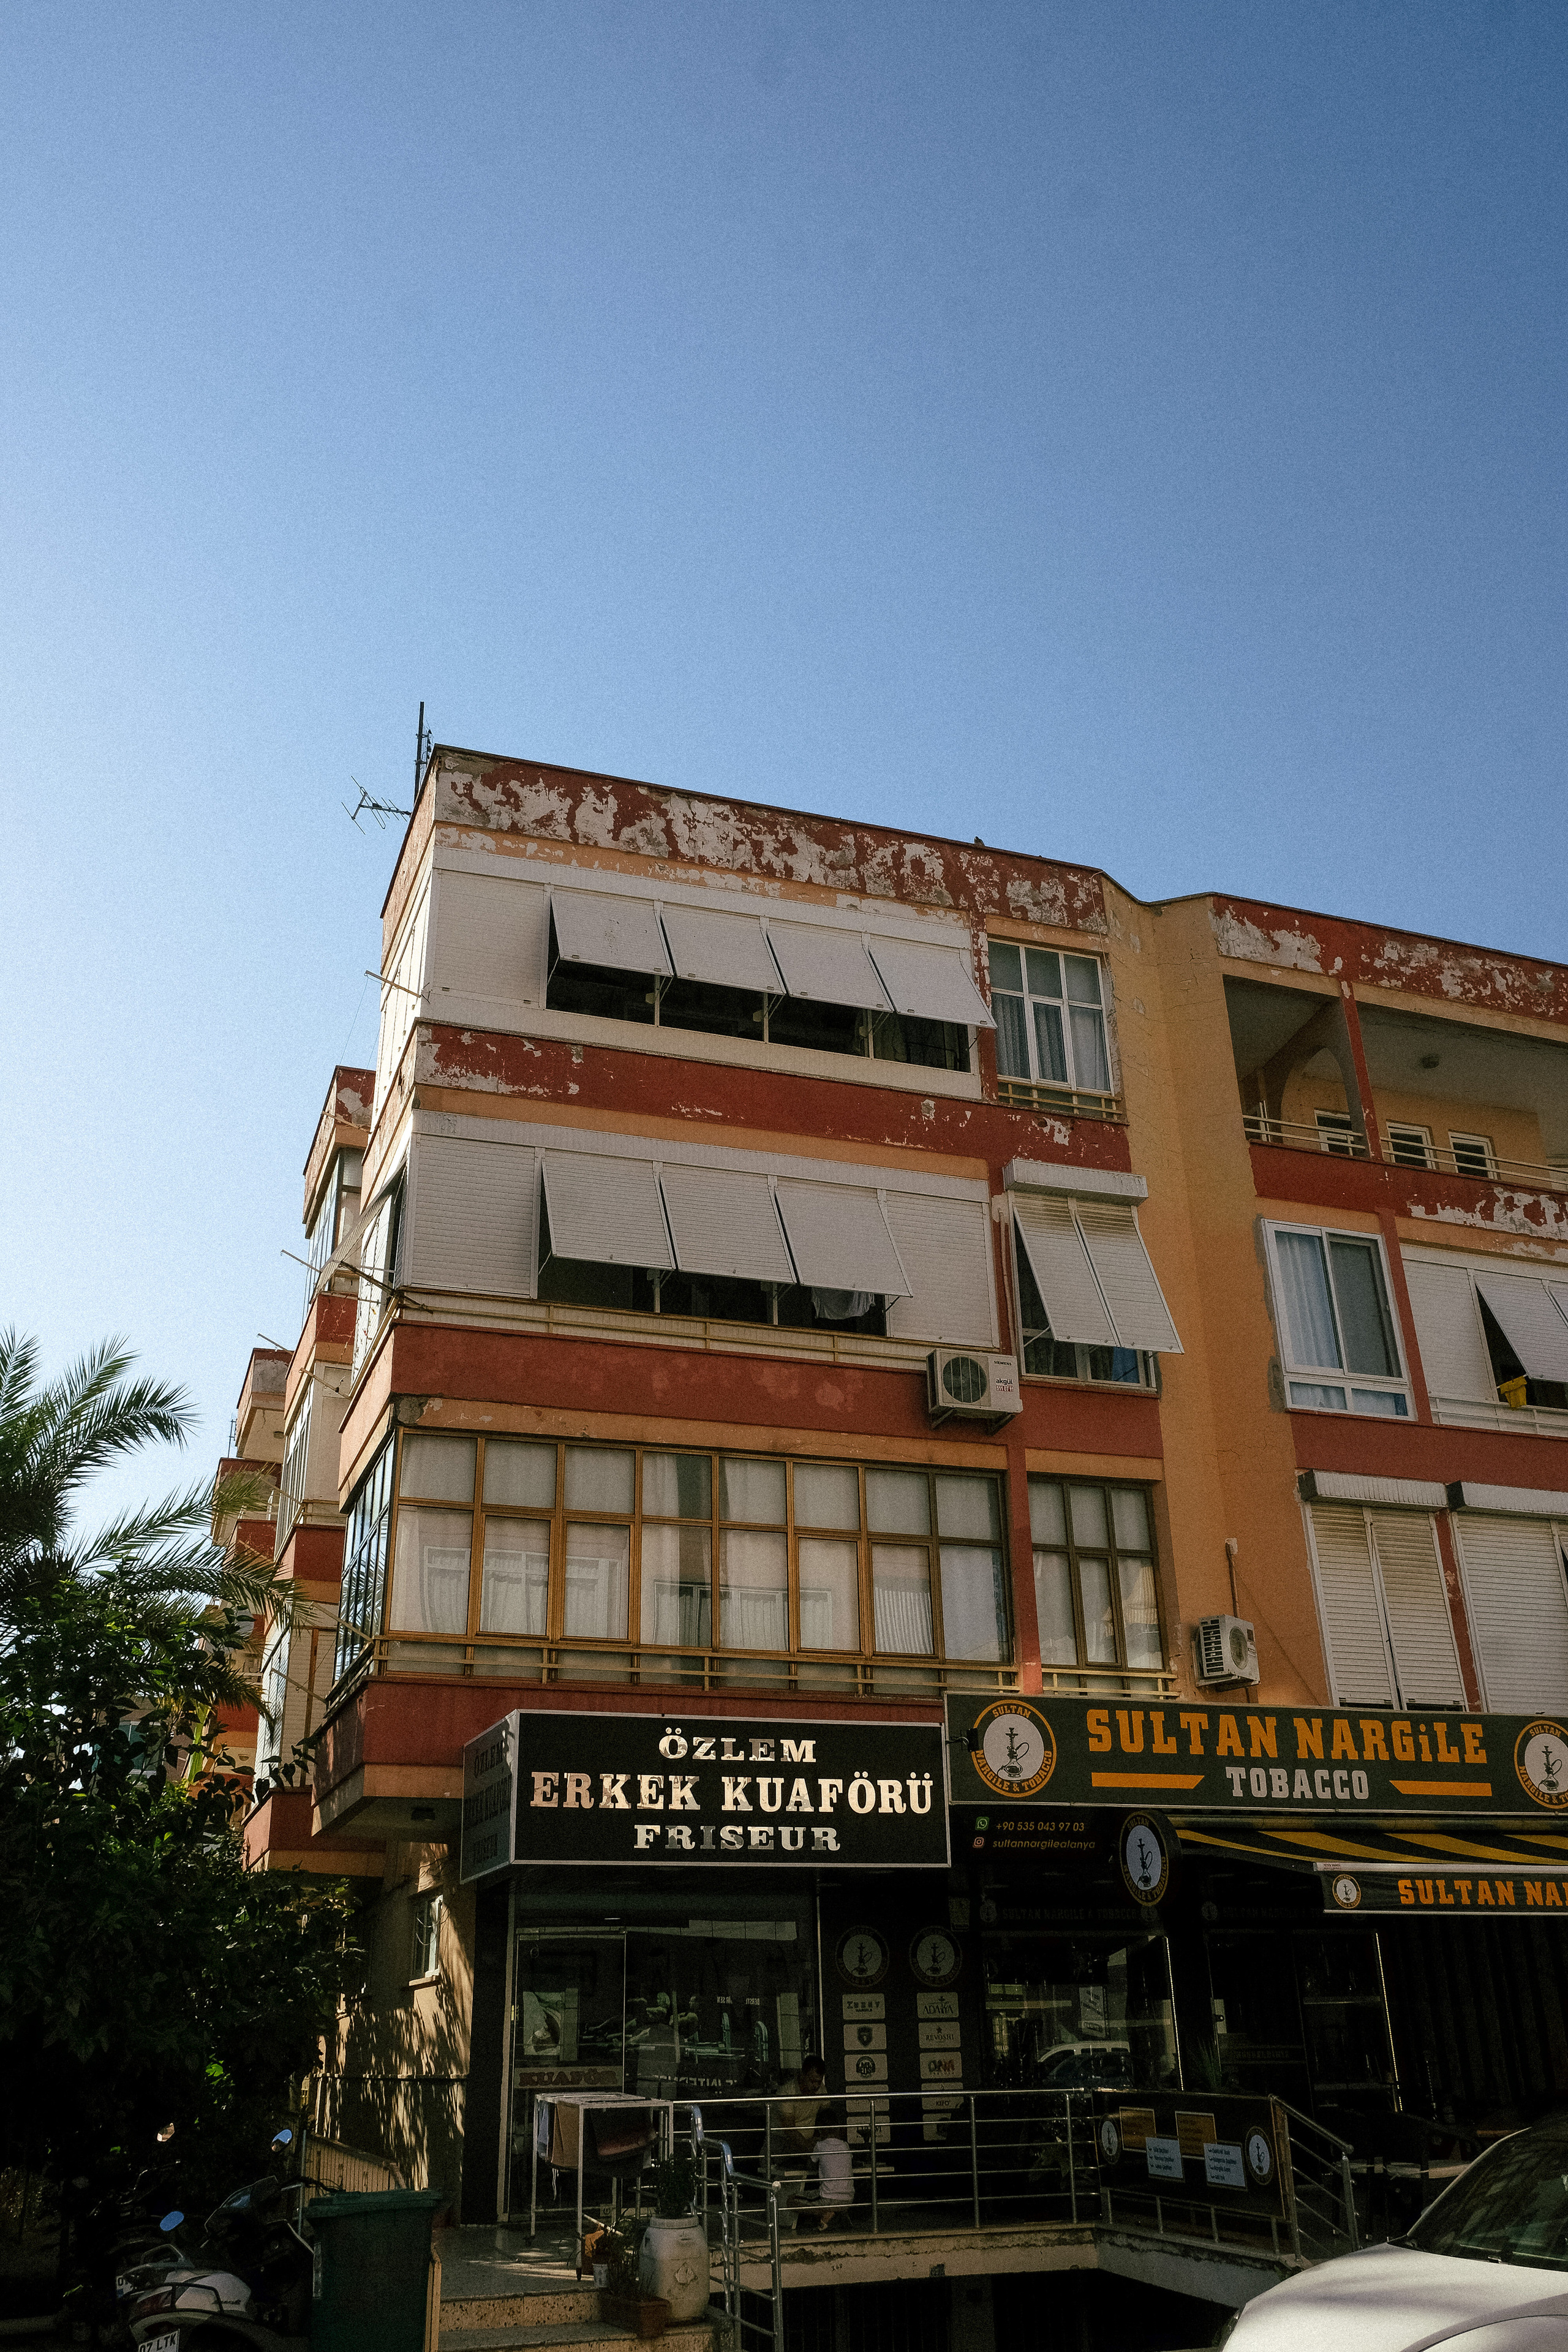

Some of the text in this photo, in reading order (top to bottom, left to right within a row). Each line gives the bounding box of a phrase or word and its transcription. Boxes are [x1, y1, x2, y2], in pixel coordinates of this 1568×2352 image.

[992, 1705, 1031, 1718] SULTAN
[1087, 1708, 1278, 1758] SULTAN
[1529, 1725, 1561, 1738] SULTAN
[658, 1727, 816, 1763] ÖZLEM
[1012, 1783, 1020, 1792] &
[1021, 1750, 1052, 1790] TOBACCO
[1226, 1766, 1369, 1800] TOBACCO
[530, 1771, 933, 1814] ERKEK KUAFÖRÜ
[996, 1821, 1085, 1832] +90 535 043 97 03
[1127, 1816, 1150, 1831] SULTAN
[633, 1823, 841, 1851] FRISEUR
[992, 1839, 1096, 1851] sultannargilealanya
[1398, 1880, 1515, 1905] SULTAN
[156, 2333, 176, 2351] LTK
